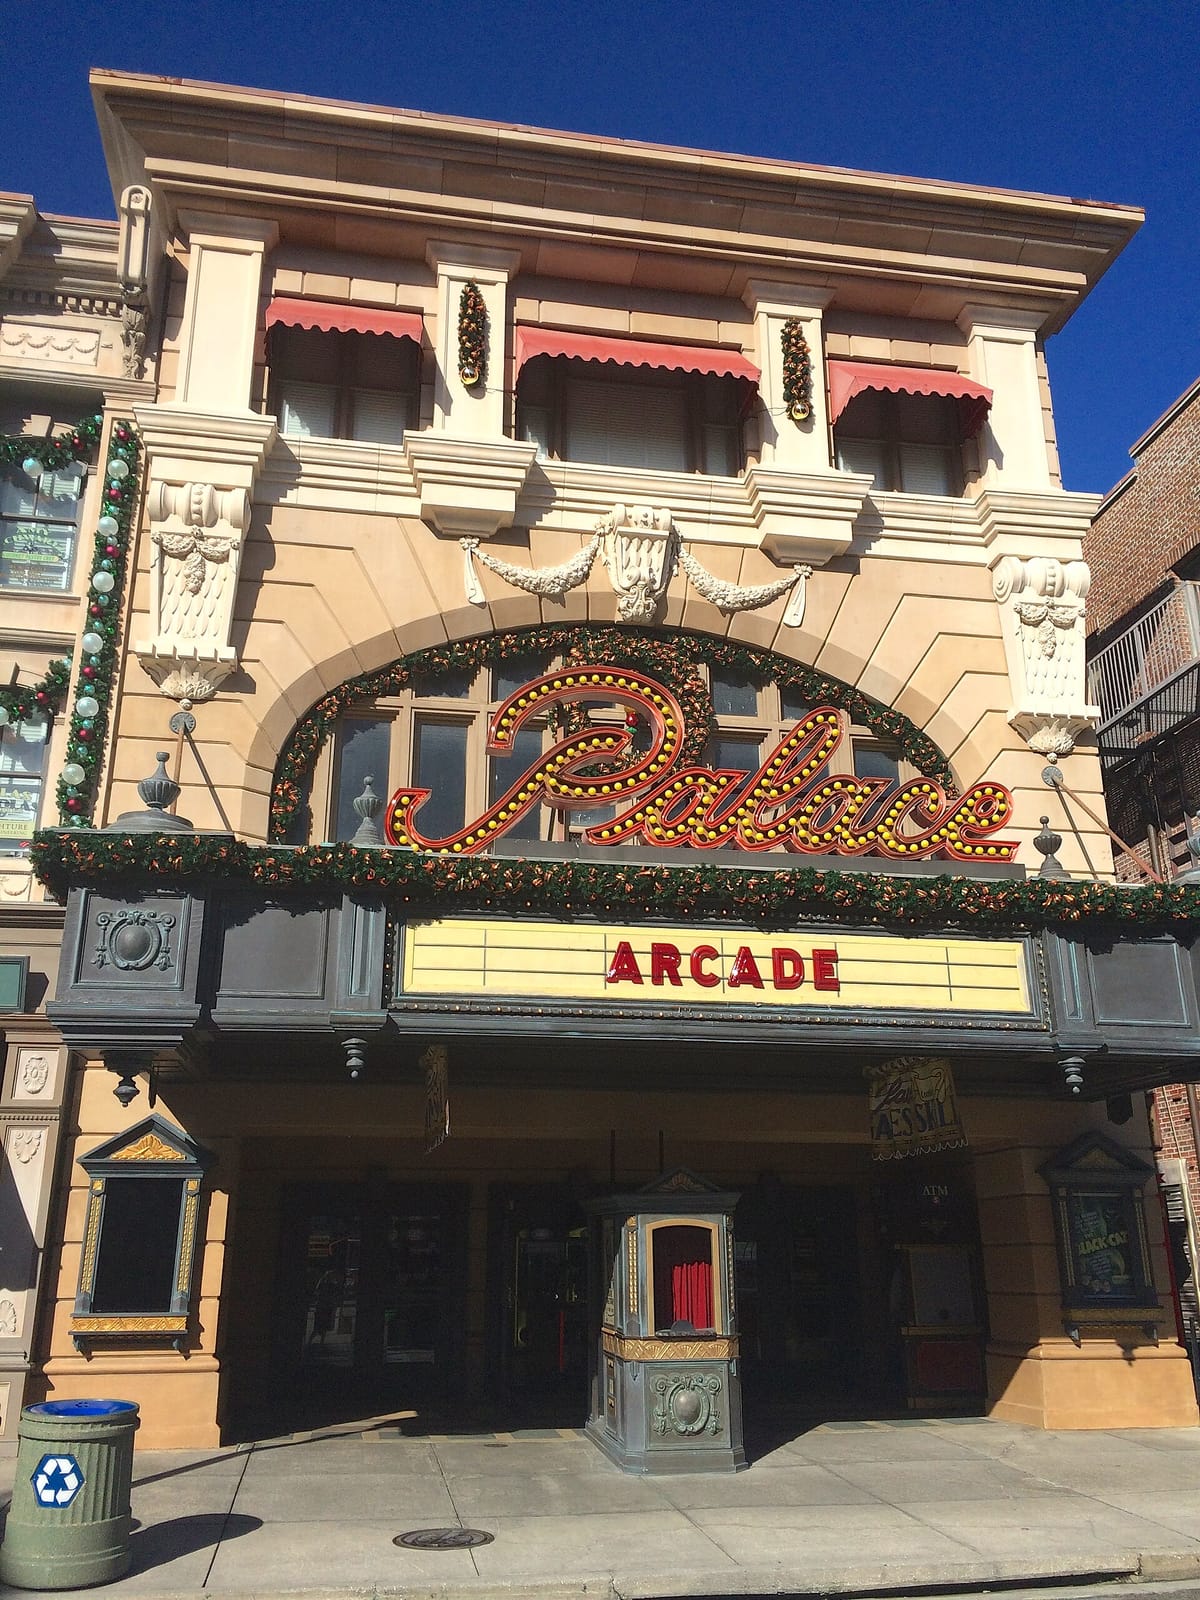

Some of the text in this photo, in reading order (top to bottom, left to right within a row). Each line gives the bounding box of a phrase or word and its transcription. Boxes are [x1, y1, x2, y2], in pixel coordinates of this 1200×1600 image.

[384, 666, 1021, 862] Palace
[606, 941, 840, 992] ARCADE
[922, 1185, 949, 1197] ATM
